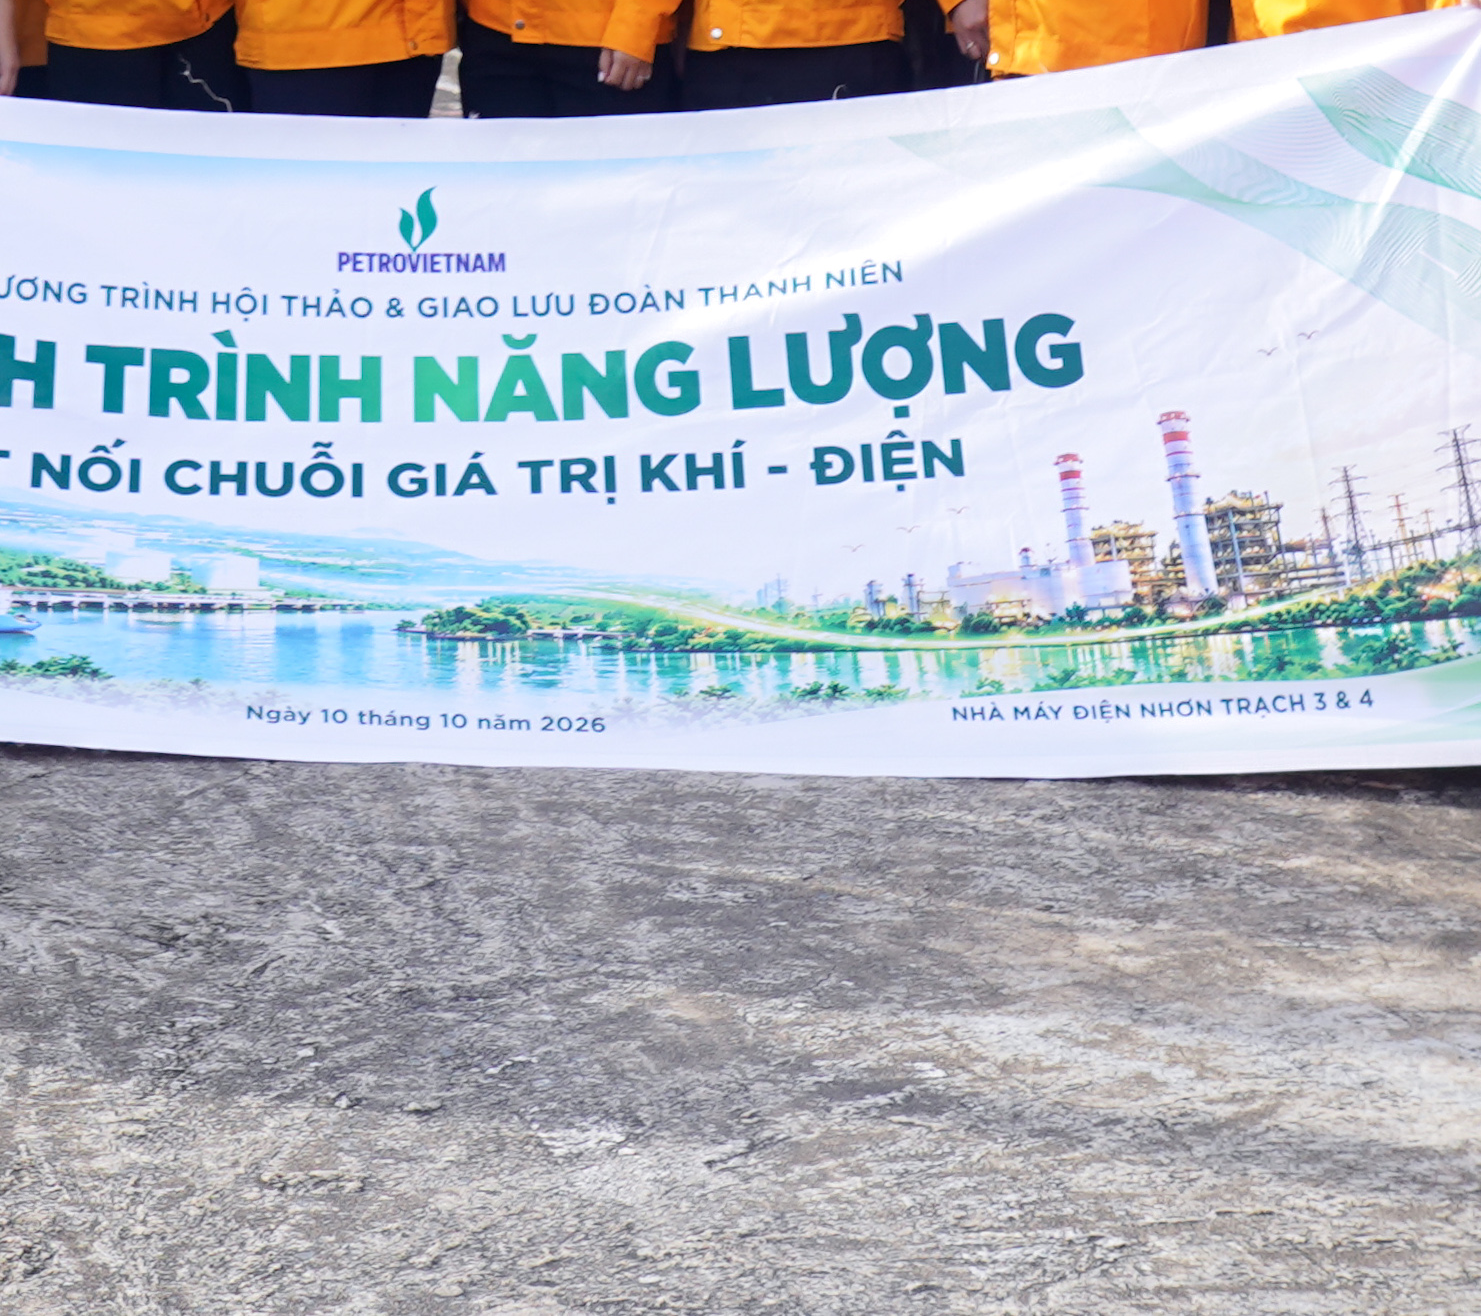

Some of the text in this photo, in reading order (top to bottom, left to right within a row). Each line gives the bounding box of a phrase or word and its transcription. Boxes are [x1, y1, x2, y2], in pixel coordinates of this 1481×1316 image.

[337, 252, 506, 273] PETROVIETNAM
[100, 281, 198, 313] TRÌNH
[211, 287, 268, 322] HỘI
[280, 288, 374, 319] THẢO
[385, 297, 405, 318] &
[417, 296, 500, 318] GIAO
[513, 292, 575, 317] LƯU
[588, 284, 685, 315] ĐOÀN
[697, 276, 811, 306] THANH
[825, 258, 904, 290] NIÊN
[84, 329, 382, 423] TRÌNH
[413, 333, 701, 423] NĂNG
[727, 313, 1084, 419] LƯỢNG
[30, 438, 142, 493] NỐI
[163, 441, 364, 498] CHUỖI
[386, 451, 498, 498] GIÁ
[517, 455, 617, 505] TRỊ
[639, 439, 746, 493] KHÍ
[767, 465, 788, 475] -
[809, 429, 965, 493] ĐIỆN
[247, 705, 606, 733] Ngày 10 tháng 10 năm 2026
[952, 689, 1373, 723] NHÀ MÁY ĐIỆN NHƠN TRẠCH 3 & 4
